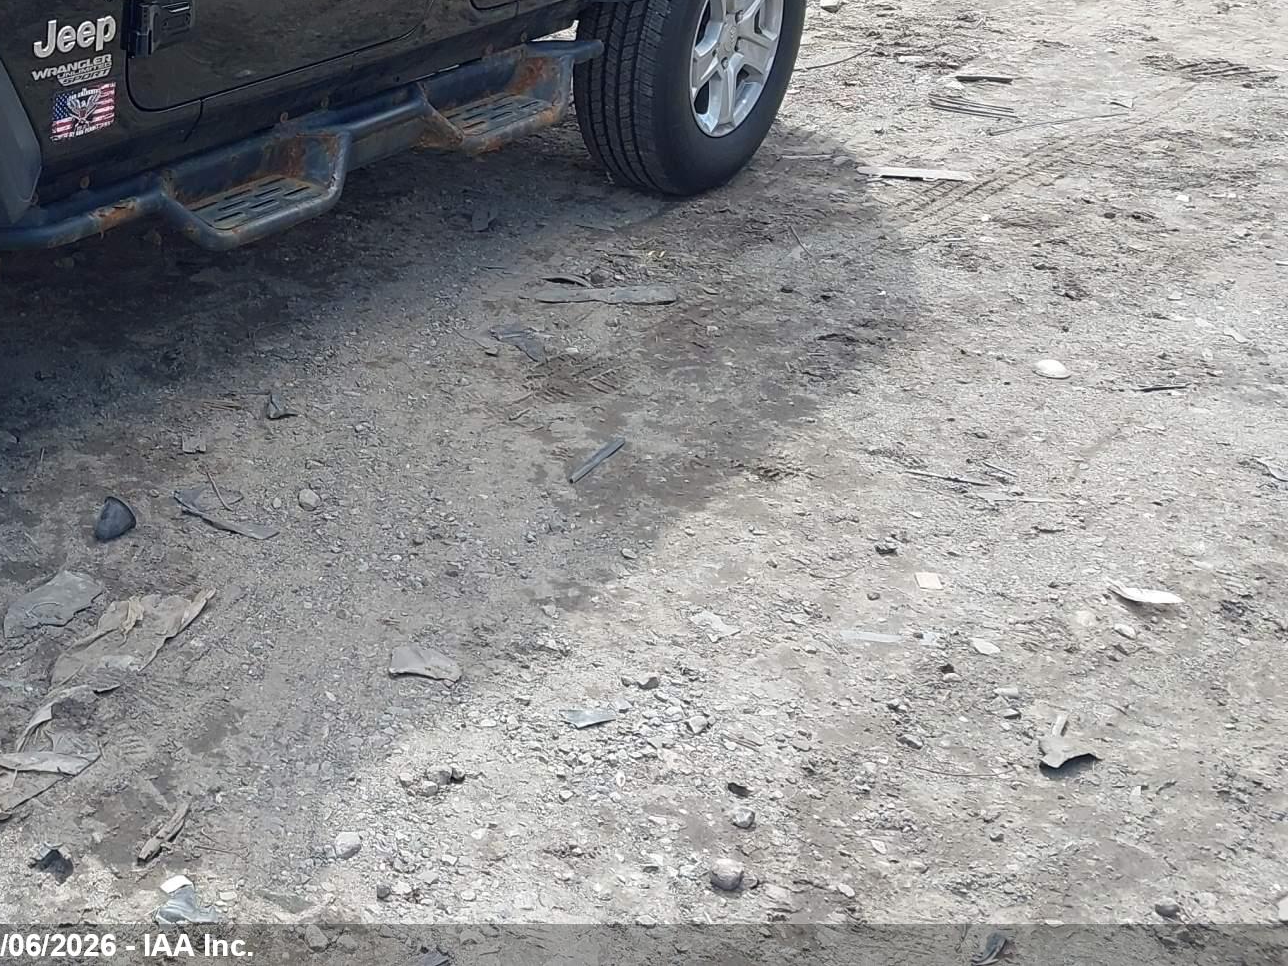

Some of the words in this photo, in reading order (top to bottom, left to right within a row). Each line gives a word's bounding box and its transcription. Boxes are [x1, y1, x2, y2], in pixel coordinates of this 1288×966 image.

[33, 15, 117, 58] Jeep
[31, 53, 113, 81] WRANGLER
[57, 61, 113, 79] UNLIMITED
